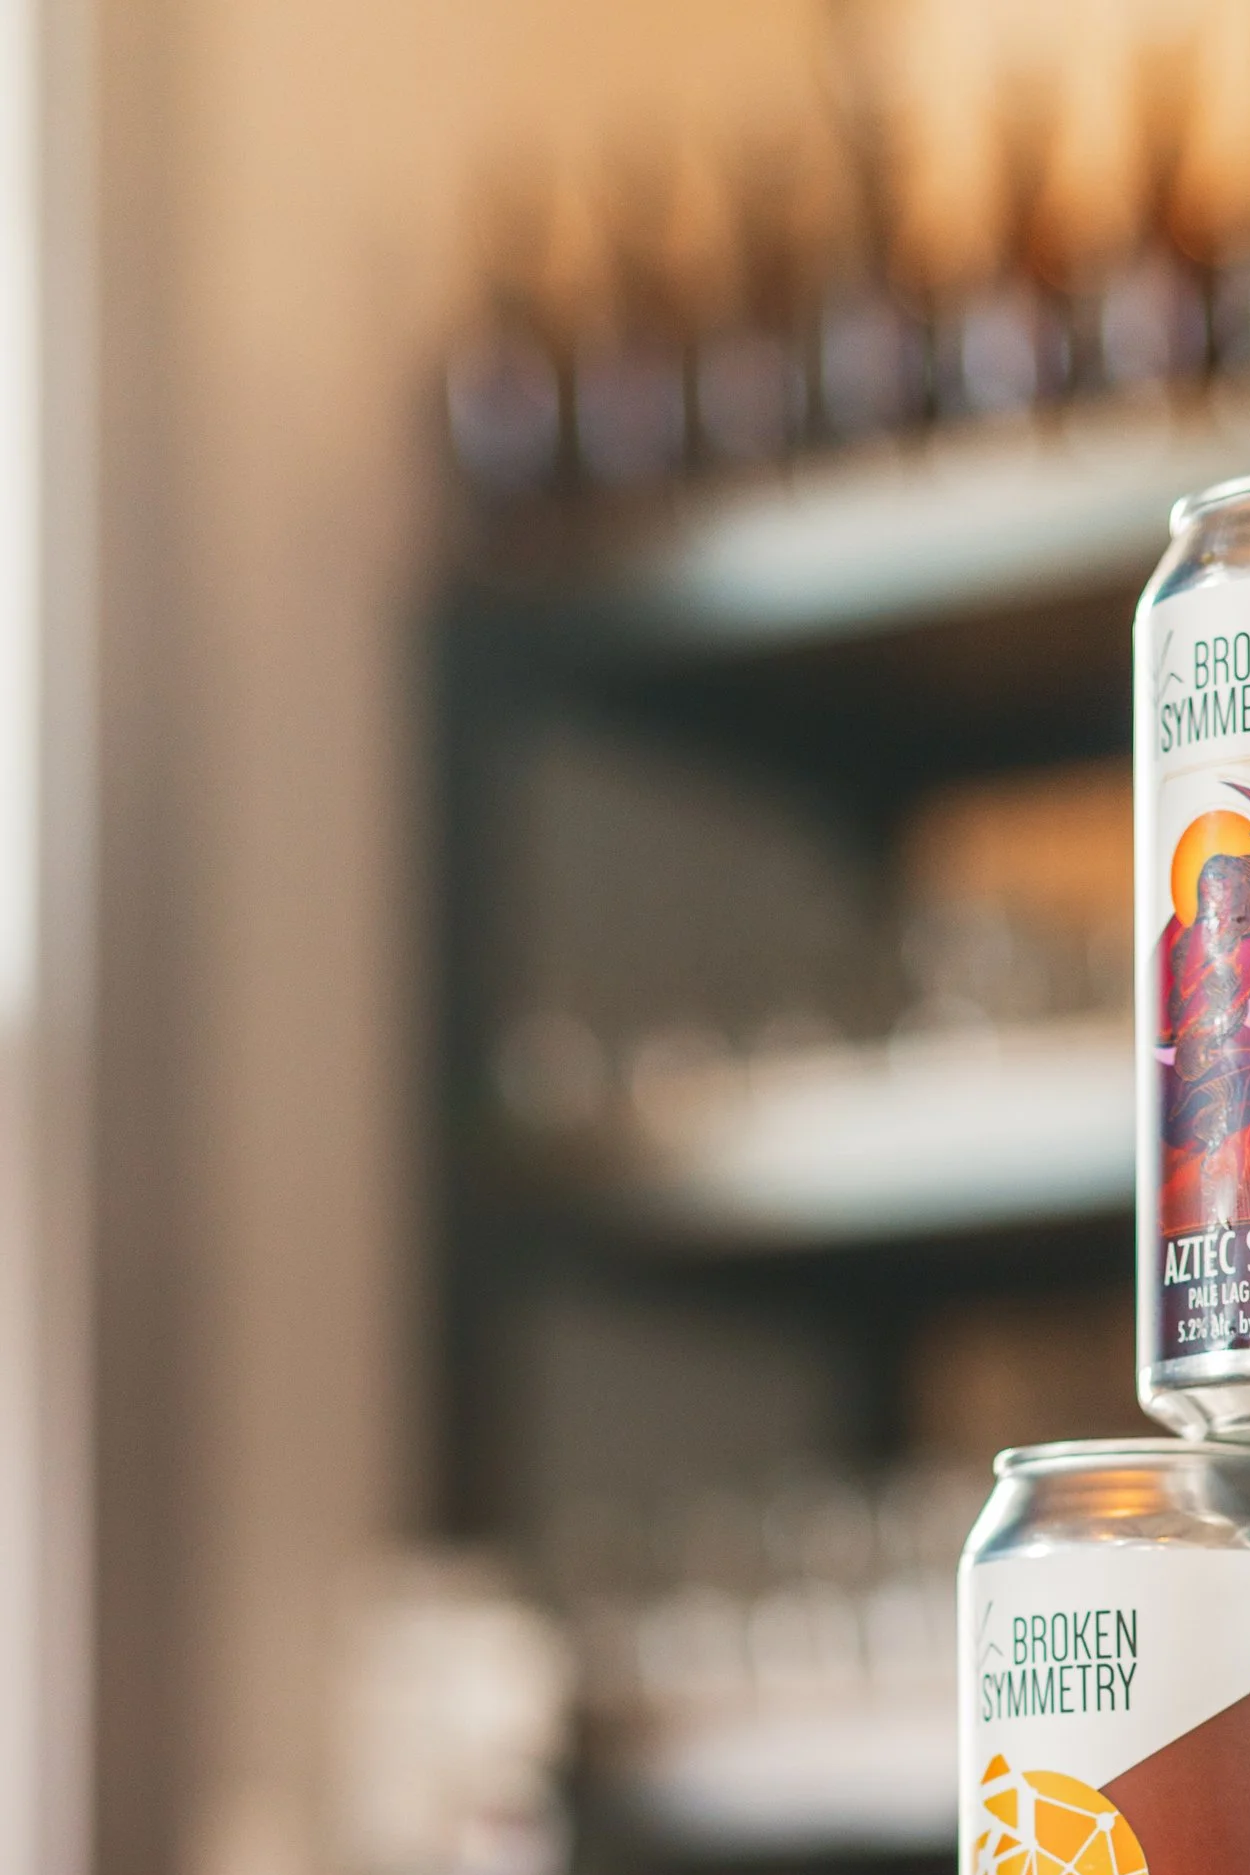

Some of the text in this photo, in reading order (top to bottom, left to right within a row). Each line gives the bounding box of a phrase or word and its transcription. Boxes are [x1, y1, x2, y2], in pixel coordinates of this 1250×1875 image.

[1164, 1230, 1237, 1287] AZTEC
[1188, 1284, 1218, 1309] PALE
[1013, 1609, 1137, 1665] BROKEN
[982, 1662, 1137, 1723] SYMMETRY
